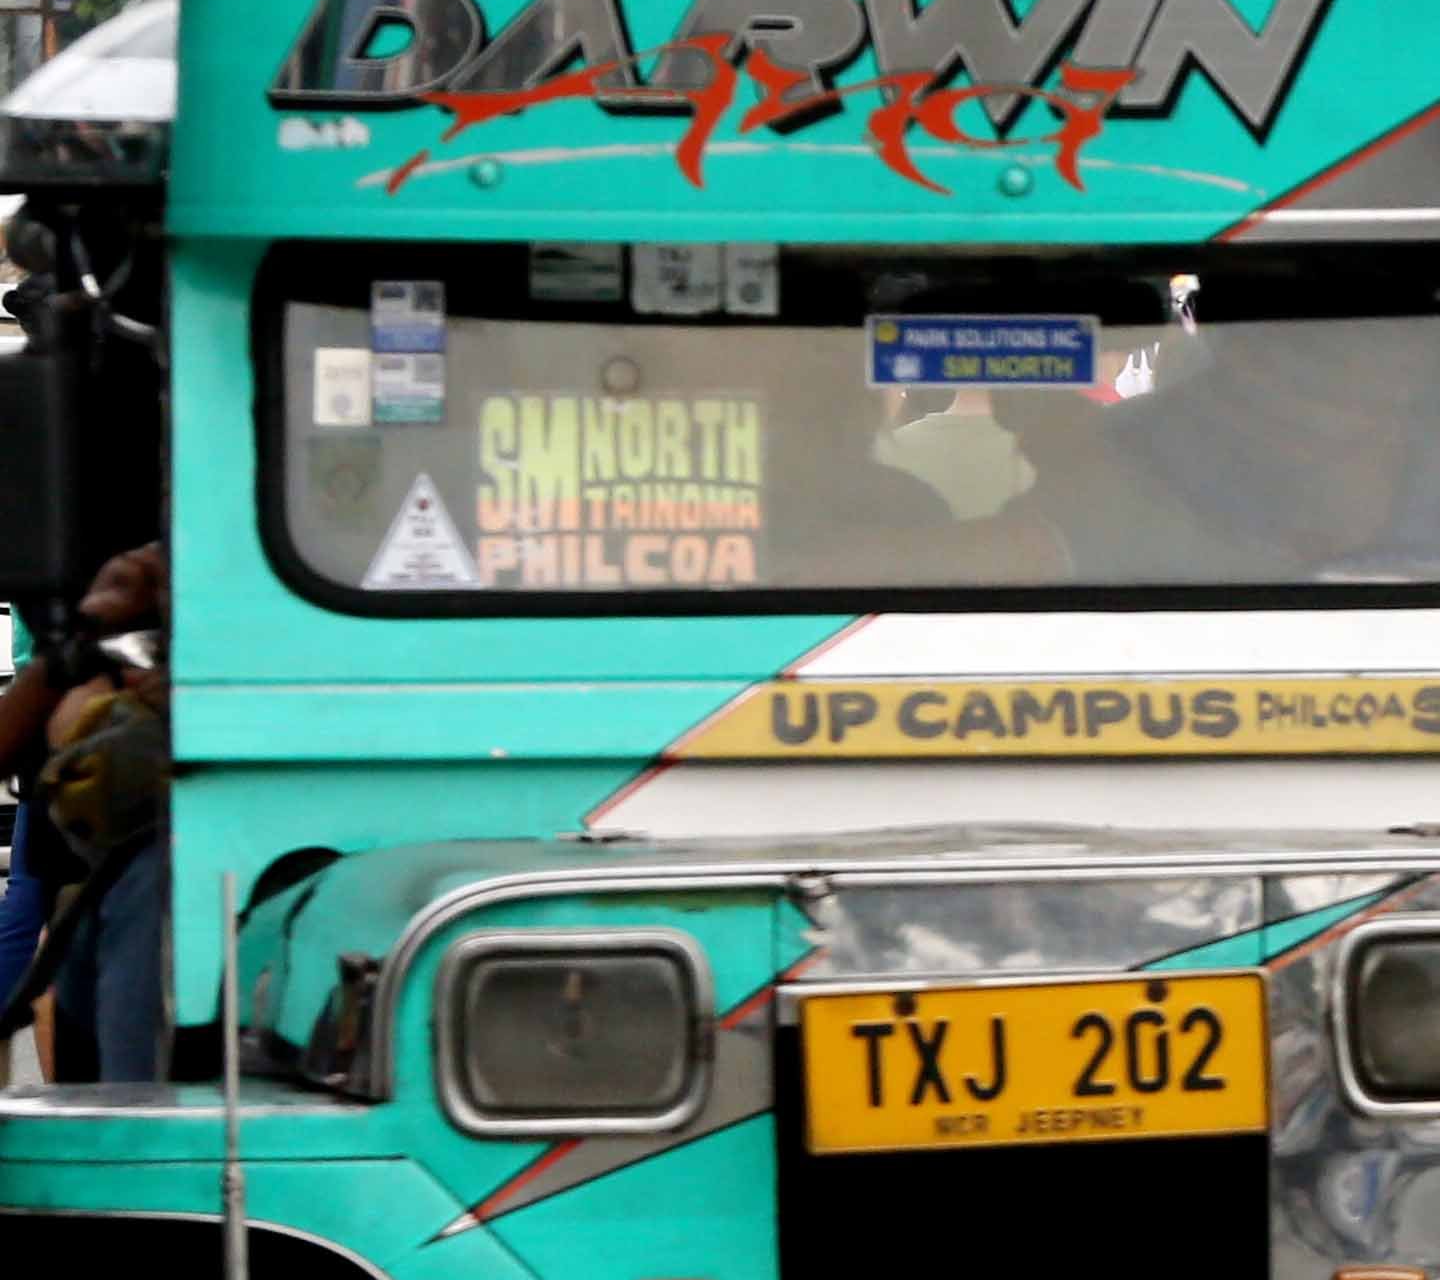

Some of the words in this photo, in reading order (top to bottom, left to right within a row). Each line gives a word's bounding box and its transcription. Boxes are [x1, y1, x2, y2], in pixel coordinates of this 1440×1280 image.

[953, 328, 1046, 348] SOLUTIONS
[943, 355, 981, 379] SM
[985, 355, 1074, 380] NORTH
[481, 396, 581, 532] SM
[583, 399, 761, 485] NORTH
[479, 534, 758, 589] PHILCOA
[769, 690, 878, 745] UP
[896, 686, 1242, 742] CAMPUS
[1256, 690, 1405, 732] PHILCOA
[851, 1014, 1007, 1109] TXJ
[1069, 1005, 1228, 1098] 202
[932, 1113, 992, 1139] NCR
[1013, 1105, 1145, 1136] JEEPNEY
